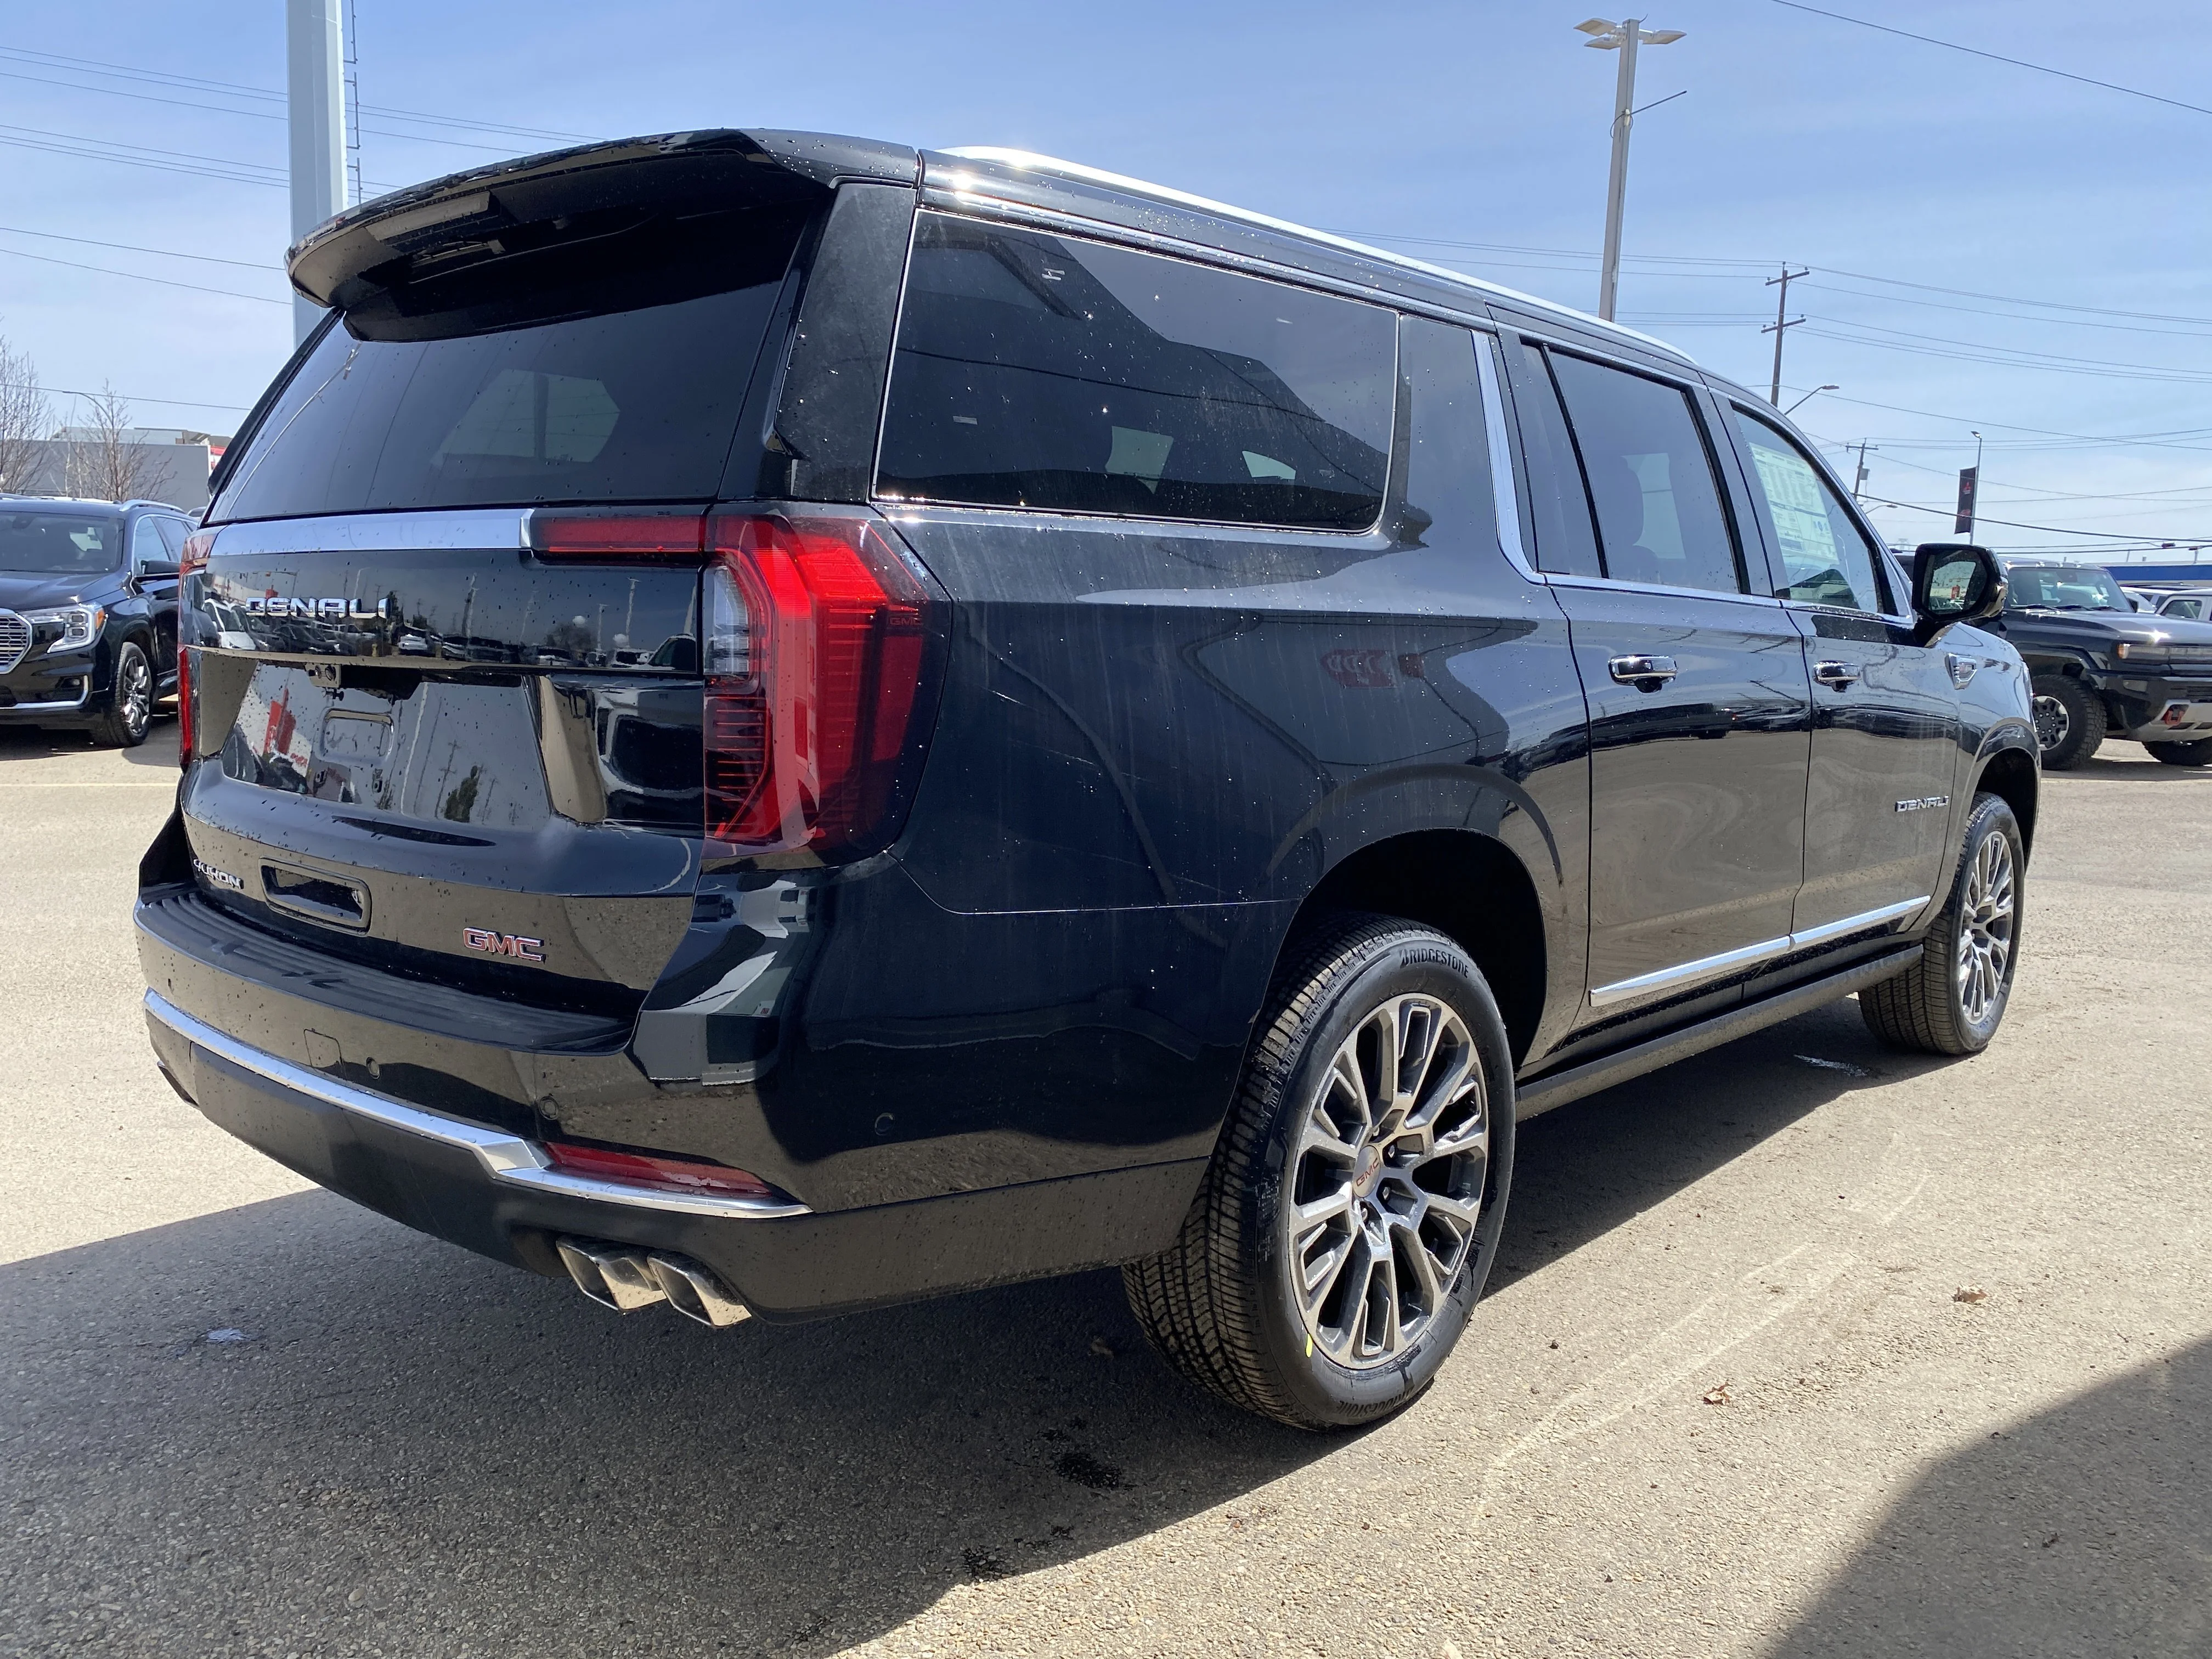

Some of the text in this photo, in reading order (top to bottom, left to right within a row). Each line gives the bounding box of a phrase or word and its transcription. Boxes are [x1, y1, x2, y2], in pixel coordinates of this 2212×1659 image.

[246, 597, 392, 619] DENALI
[890, 617, 923, 625] GMC
[1894, 795, 1949, 812] DENALI
[193, 859, 244, 890] YUKON
[462, 927, 546, 961] GMC
[1400, 948, 1469, 978] BRIDGESTONE
[1356, 1157, 1379, 1187] GMC
